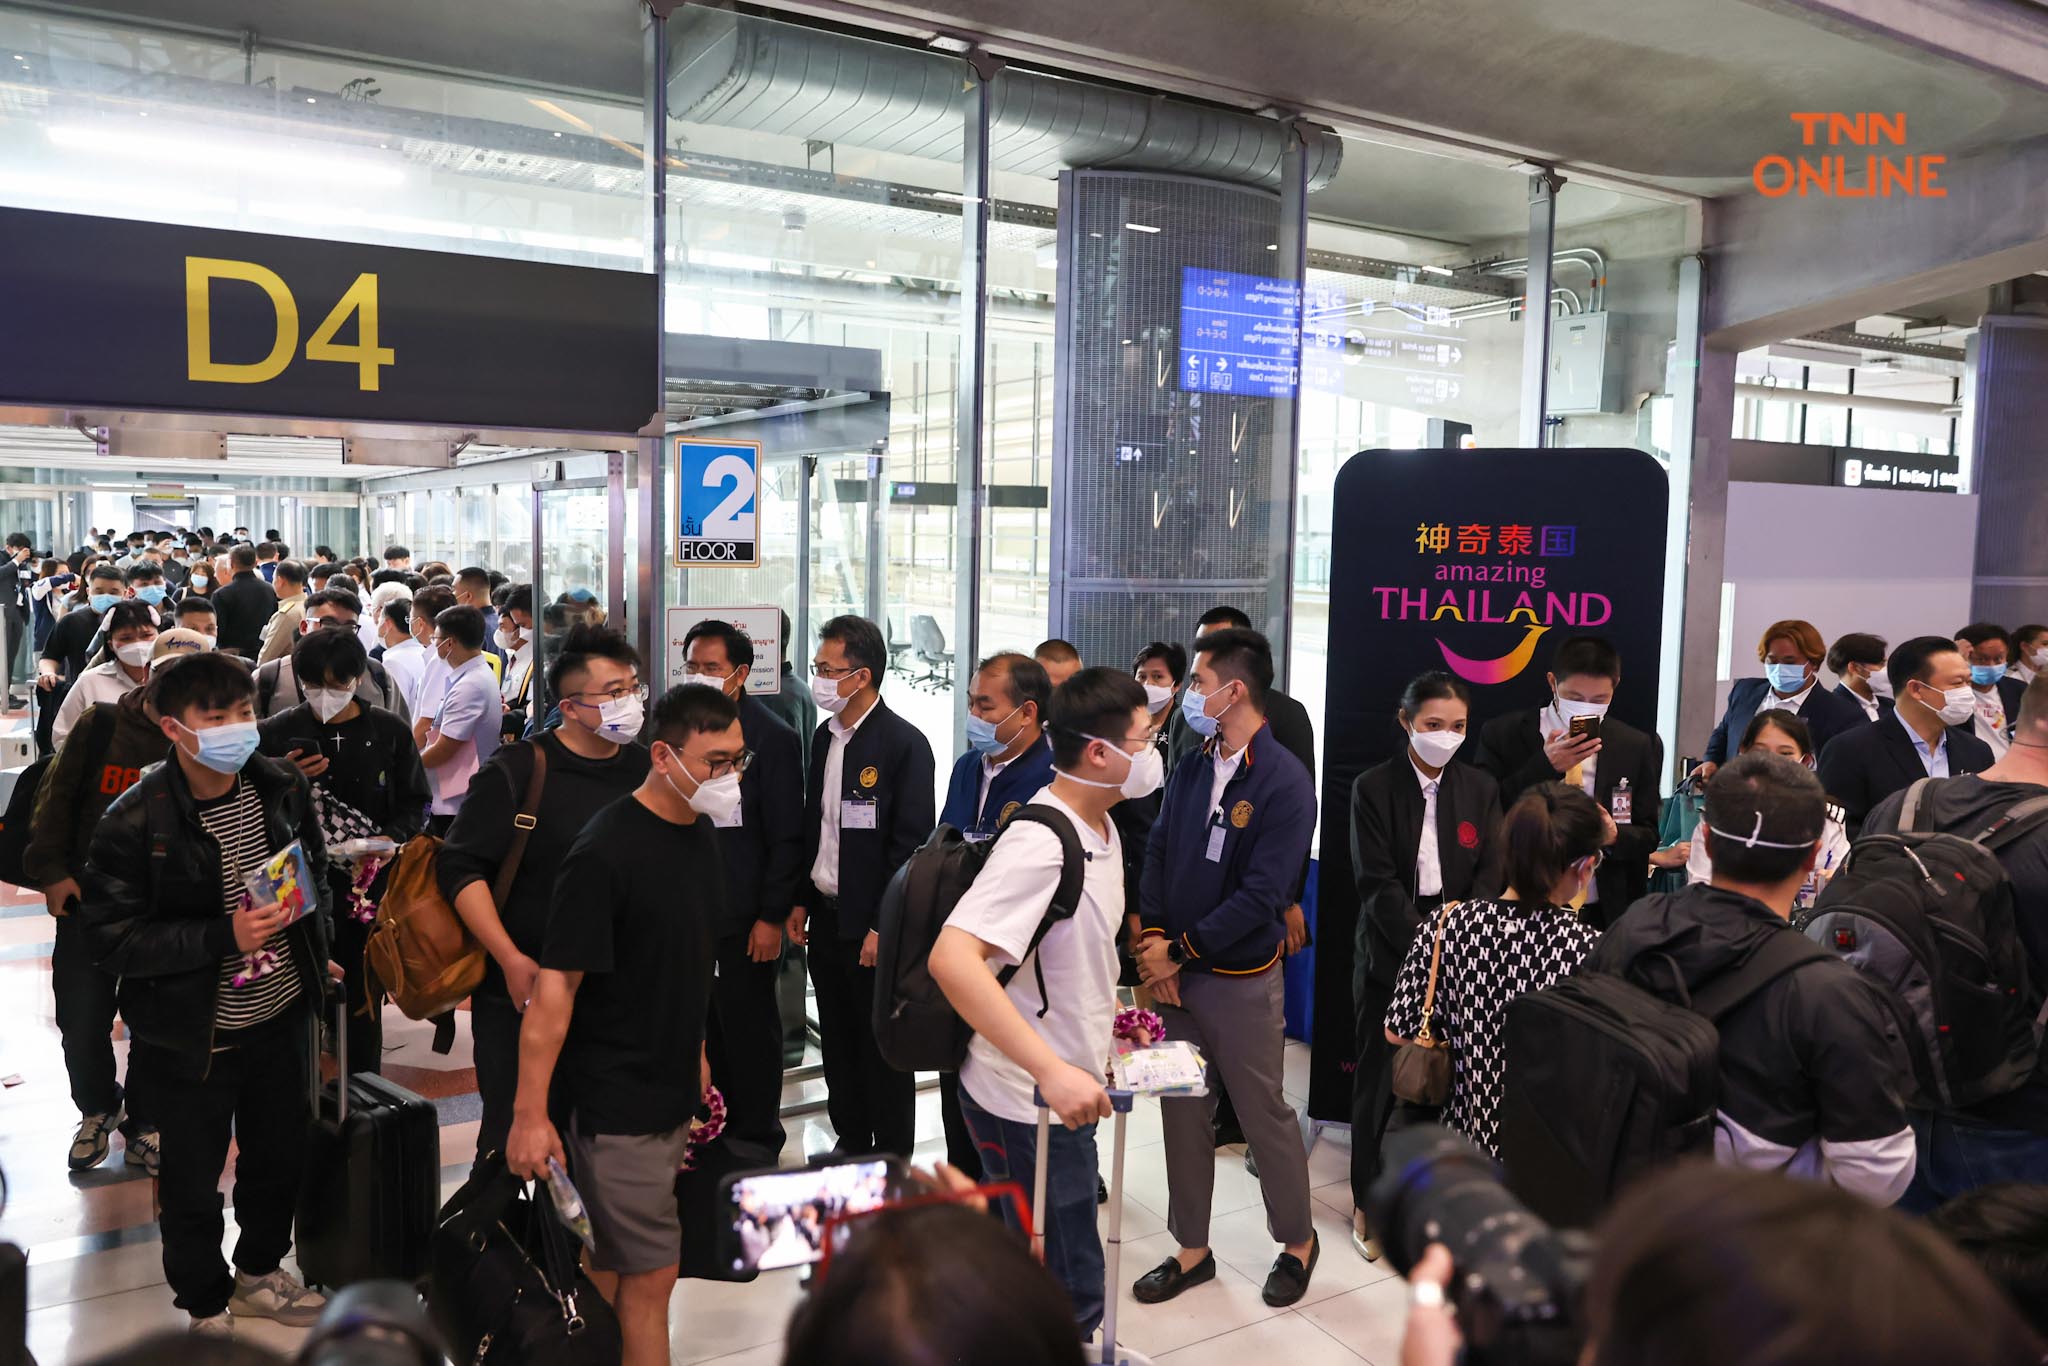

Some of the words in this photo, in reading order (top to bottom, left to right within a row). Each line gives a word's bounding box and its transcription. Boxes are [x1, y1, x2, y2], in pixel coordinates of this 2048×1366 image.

[186, 256, 395, 391] D4
[702, 454, 755, 538] 2
[681, 516, 701, 536] ชั้น
[1415, 522, 1577, 557] 神奇泰国
[681, 541, 737, 560] FLOOR
[1434, 560, 1547, 588] amazing
[1372, 586, 1612, 626] THAILAND
